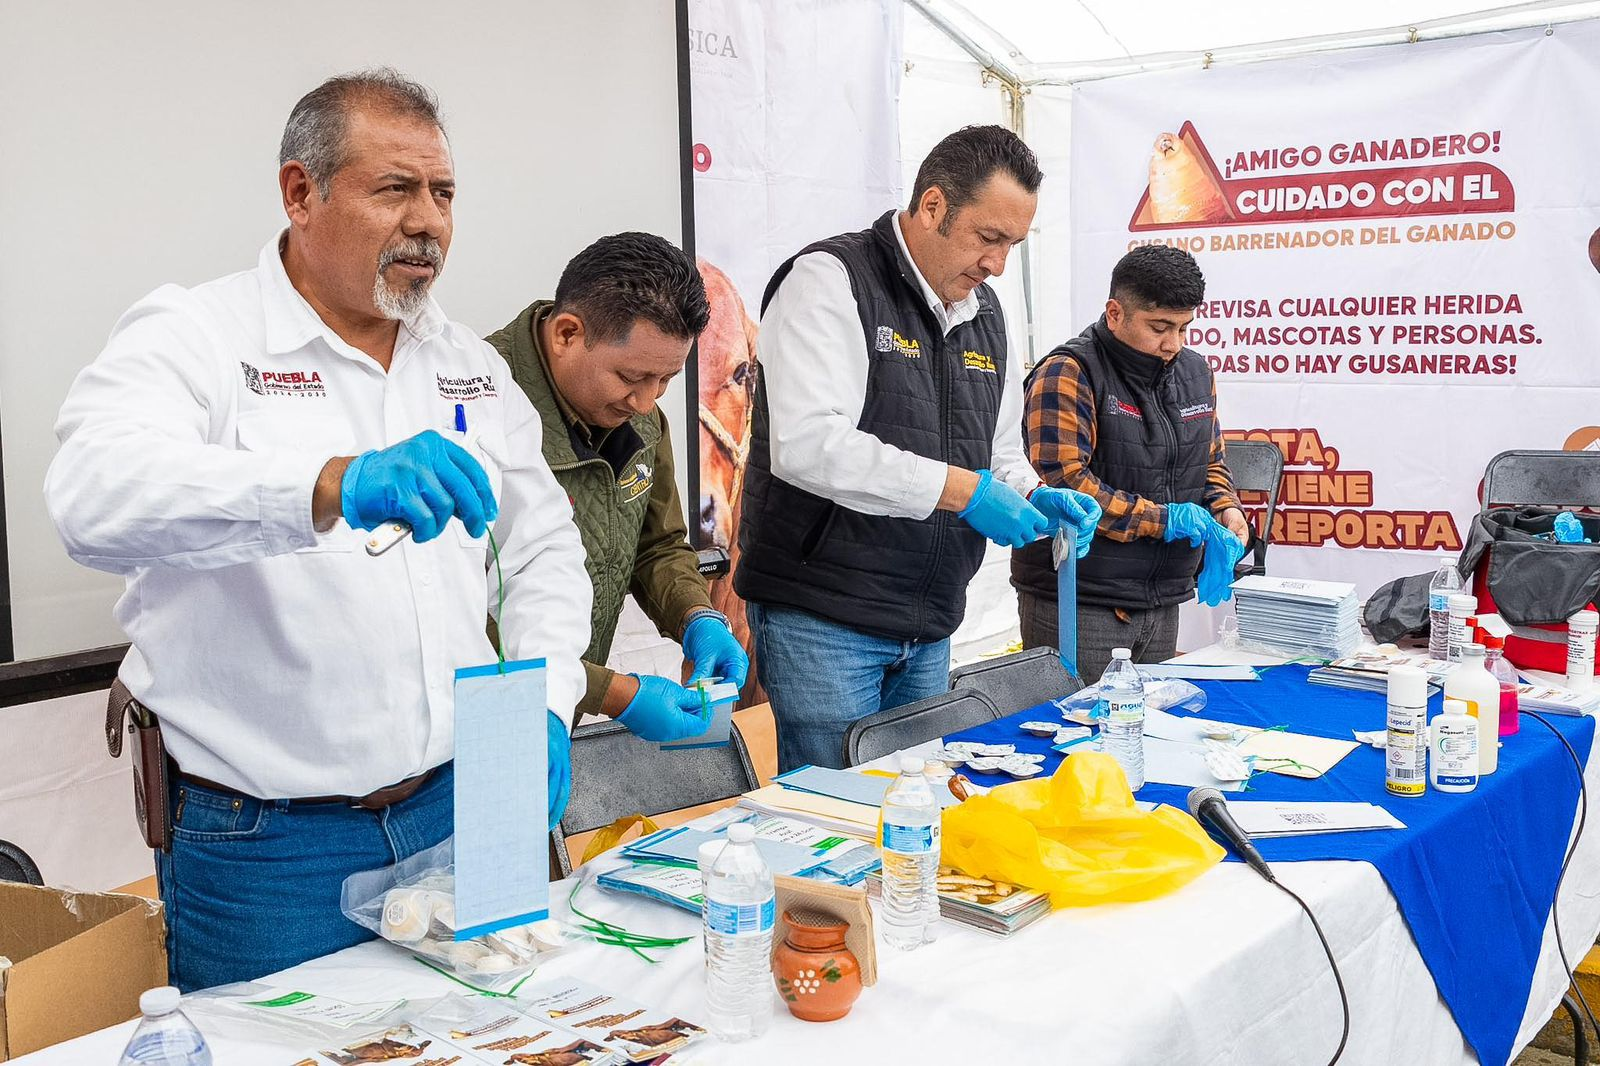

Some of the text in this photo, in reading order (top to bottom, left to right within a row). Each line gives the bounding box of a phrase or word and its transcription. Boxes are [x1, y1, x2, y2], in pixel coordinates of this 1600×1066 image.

[1225, 130, 1501, 178] ¡AMIGO GANADERO!
[1236, 173, 1500, 214] CUIDADO CON EL
[1210, 228, 1354, 252] BARRENADOR
[1360, 227, 1401, 245] DEL
[1406, 221, 1516, 243] GANADO
[1195, 294, 1523, 319] REVISA CUALQUIER HERIDA
[1185, 324, 1543, 348] DO, MASCOTAS Y PERSONAS.
[1207, 354, 1517, 375] DAS NO HAY GUSANERAS!
[262, 371, 322, 383] PUEBLA
[1387, 782, 1412, 792] PELIGRO
